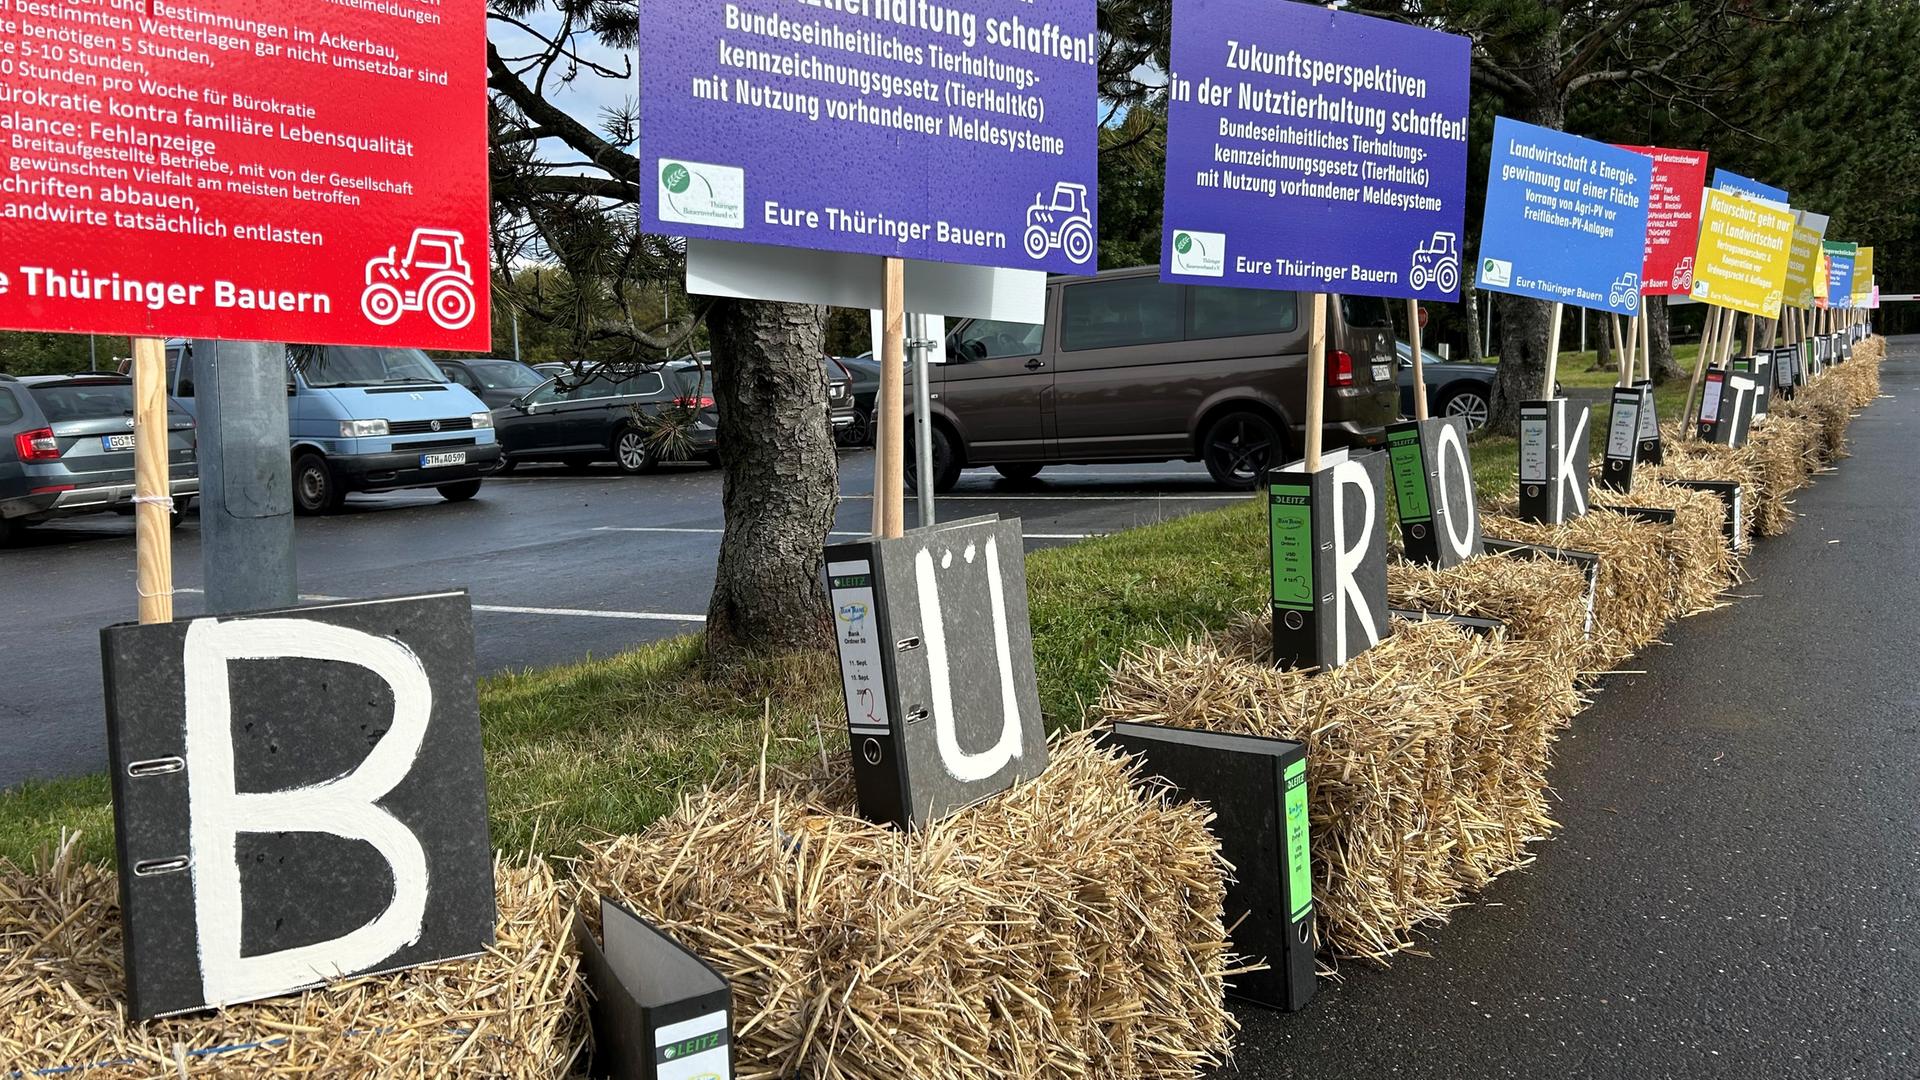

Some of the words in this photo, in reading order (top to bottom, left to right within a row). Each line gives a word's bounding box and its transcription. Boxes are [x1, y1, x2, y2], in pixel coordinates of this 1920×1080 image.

[16, 0, 133, 33] bestimmten
[139, 18, 250, 50] Wetterlagen
[255, 38, 283, 57] gar
[287, 44, 328, 65] nicht
[333, 53, 414, 80] umsetzbar
[417, 70, 448, 86] sind
[23, 19, 116, 51] benötigen
[121, 36, 132, 52] 5
[138, 40, 215, 68] Stunden,
[153, 0, 288, 39] Bestimmungen
[294, 27, 315, 44] im
[319, 31, 400, 61] Ackerbau,
[725, 3, 923, 66] Bundeseinheitliches
[928, 43, 1040, 91] Tierhaltungs-
[799, 0, 976, 47] erhaltung
[985, 16, 1095, 66] schaffen!
[21, 41, 64, 62] 5-10
[69, 48, 150, 77] Stunden,
[719, 38, 940, 102] kennzeichnungsgesetz
[945, 79, 1045, 124] (TierHaltkG)
[1226, 39, 1427, 99] Zukunftsperspektiven
[19, 60, 97, 87] Stunden
[102, 76, 133, 92] pro
[138, 80, 199, 101] Woche
[203, 88, 228, 106] für
[233, 93, 316, 119] Bürokratie
[1170, 72, 1191, 103] in
[1198, 77, 1232, 108] der
[1238, 82, 1387, 135] Nutztierhaltung
[1391, 108, 1467, 142] schaffen!
[90, 122, 216, 157] Fehlanzeige
[109, 97, 178, 125] kontra
[184, 108, 274, 137] familiäre
[280, 122, 414, 157] Lebensqualität
[692, 74, 728, 102] mit
[735, 78, 820, 121] Nutzung
[825, 98, 943, 136] vorhandener
[949, 114, 1065, 156] Meldesysteme
[1219, 117, 1349, 152] Bundeseinheitliches
[1352, 133, 1428, 162] Tierhaltungs-
[9, 155, 128, 181] gewünschten
[133, 166, 193, 189] Vielfalt
[197, 177, 223, 191] am
[227, 180, 288, 199] meisten
[293, 186, 360, 206] betroffen
[12, 133, 156, 165] Breitaufgestellte
[160, 152, 234, 177] Betriebe,
[239, 163, 264, 179] mit
[269, 167, 297, 182] von
[301, 169, 326, 185] der
[330, 173, 414, 196] Gesellschaft
[1214, 143, 1358, 178] kennzeichnungsgesetz
[1361, 159, 1430, 188] (TierHaltkG)
[1502, 164, 1561, 193] gewinnung
[1563, 177, 1581, 194] auf
[1582, 181, 1608, 201] einer
[1610, 186, 1640, 209] Fläche
[1509, 138, 1588, 174] Landwirtschaft
[1590, 159, 1598, 176] &
[1600, 161, 1638, 187] Energie-
[0, 173, 93, 200] chriften
[100, 184, 201, 214] abbauen,
[1196, 168, 1219, 188] mit
[1223, 170, 1277, 198] Nutzung
[1280, 179, 1361, 203] vorhandener
[1363, 184, 1443, 213] Meldesysteme
[1525, 188, 1557, 209] Vorrang
[1559, 198, 1573, 212] von
[1575, 202, 1604, 217] Agri-PV
[1604, 209, 1617, 221] vor
[1711, 196, 1756, 223] Naturschutz
[1757, 213, 1776, 228] geht
[1776, 219, 1791, 232] nur
[113, 209, 228, 238] tatsächlich
[233, 222, 323, 246] entlasten
[763, 200, 820, 229] Eure
[824, 207, 931, 244] Thüringer
[936, 220, 1006, 249] Bauern
[1524, 206, 1615, 239] Freiflächen-PV-Anlagen
[1710, 220, 1724, 234] mit
[1726, 222, 1784, 251] Landwirtschaft
[20, 265, 205, 311] Thüringer
[214, 279, 331, 314] Bauern
[1236, 256, 1273, 275] Eure
[1275, 258, 1349, 283] Thüringer
[1351, 264, 1399, 284] Bauern
[1516, 276, 1536, 290] Eure
[1537, 279, 1576, 297] Thüringer
[1577, 287, 1603, 302] Bauern
[1729, 375, 1756, 449] T
[111, 436, 125, 447] GÖ
[426, 455, 440, 465] GTH
[1556, 399, 1590, 525] K
[1281, 496, 1306, 505] LEITZ
[1437, 423, 1474, 559] O
[841, 576, 866, 587] LEITZ
[1332, 459, 1380, 667] R
[914, 532, 1024, 783] Ü
[1290, 772, 1305, 788] LEITZ
[182, 617, 433, 1008] B
[676, 1032, 719, 1057] LEITZ
